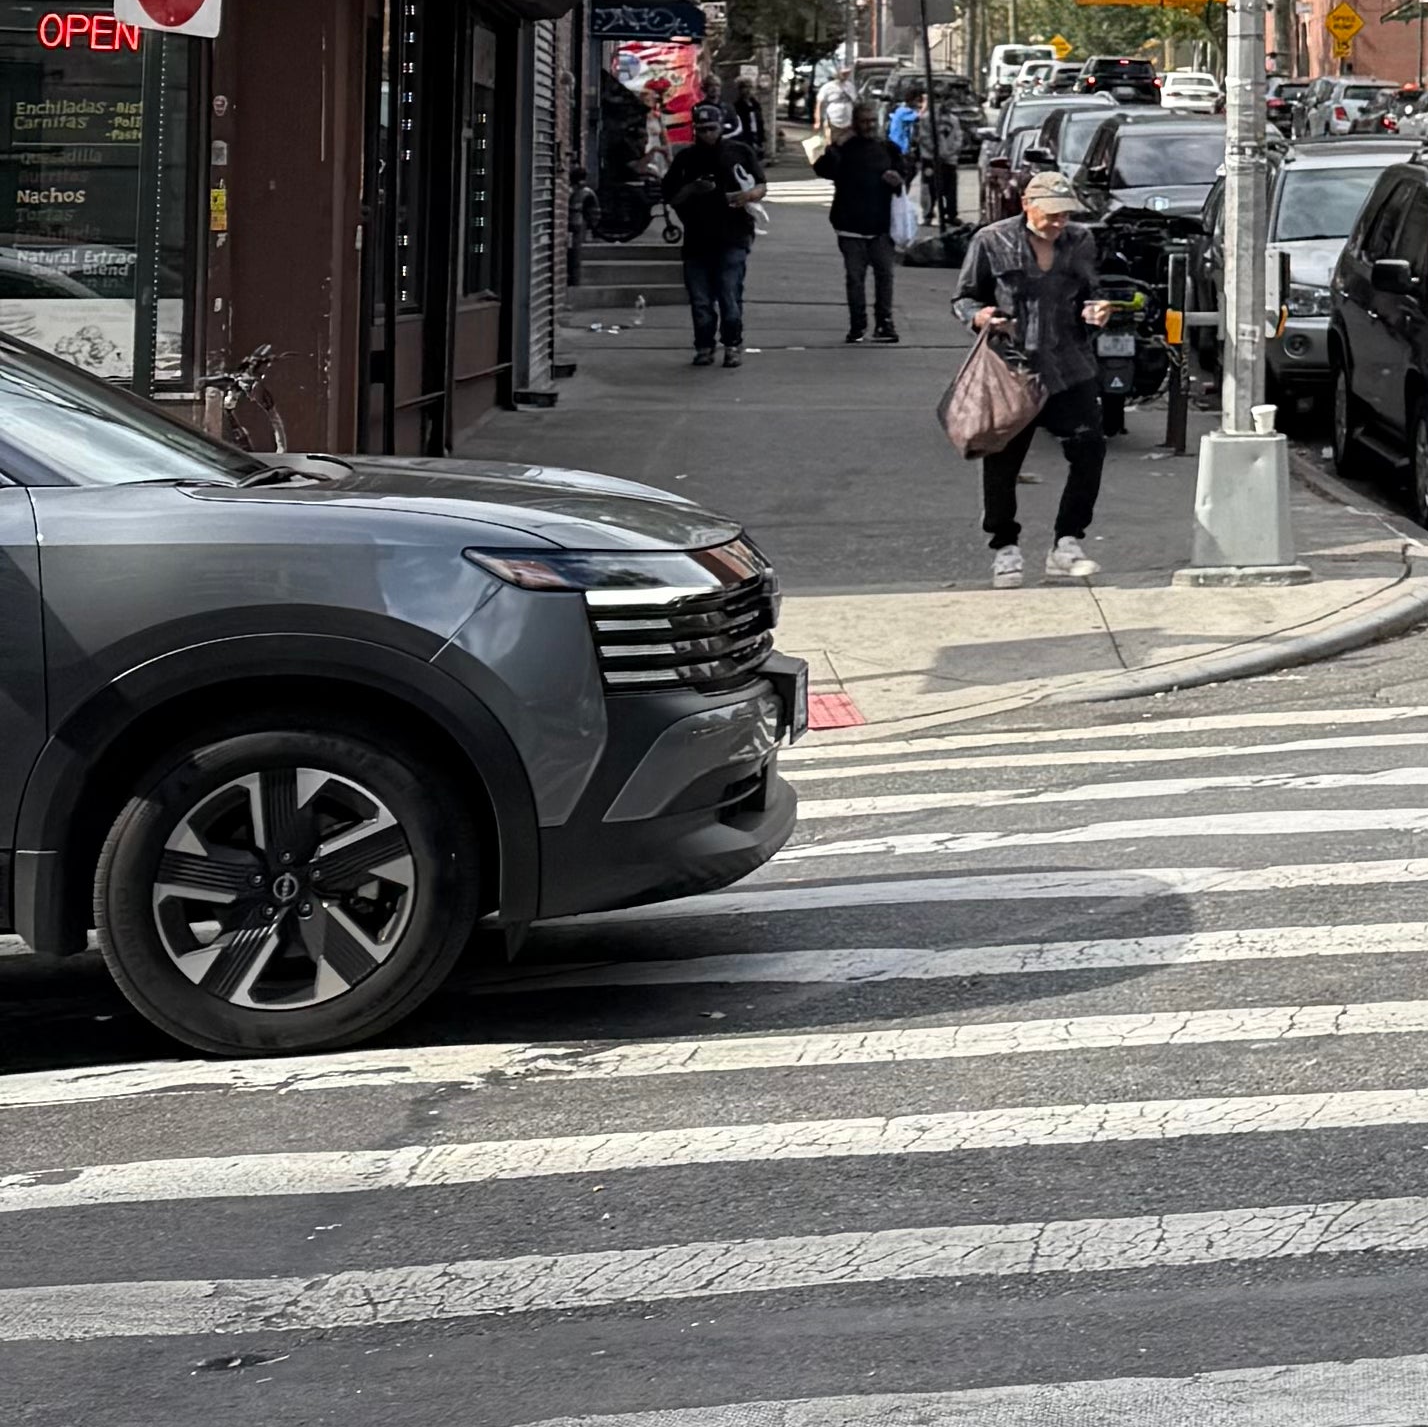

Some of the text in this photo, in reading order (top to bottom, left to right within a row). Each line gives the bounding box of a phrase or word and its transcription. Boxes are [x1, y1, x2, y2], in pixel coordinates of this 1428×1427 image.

[38, 12, 140, 51] OPEN
[15, 98, 107, 115] Enchiladas
[16, 187, 86, 204] Nachos
[17, 249, 77, 265] Natural
[82, 264, 129, 277] Blend
